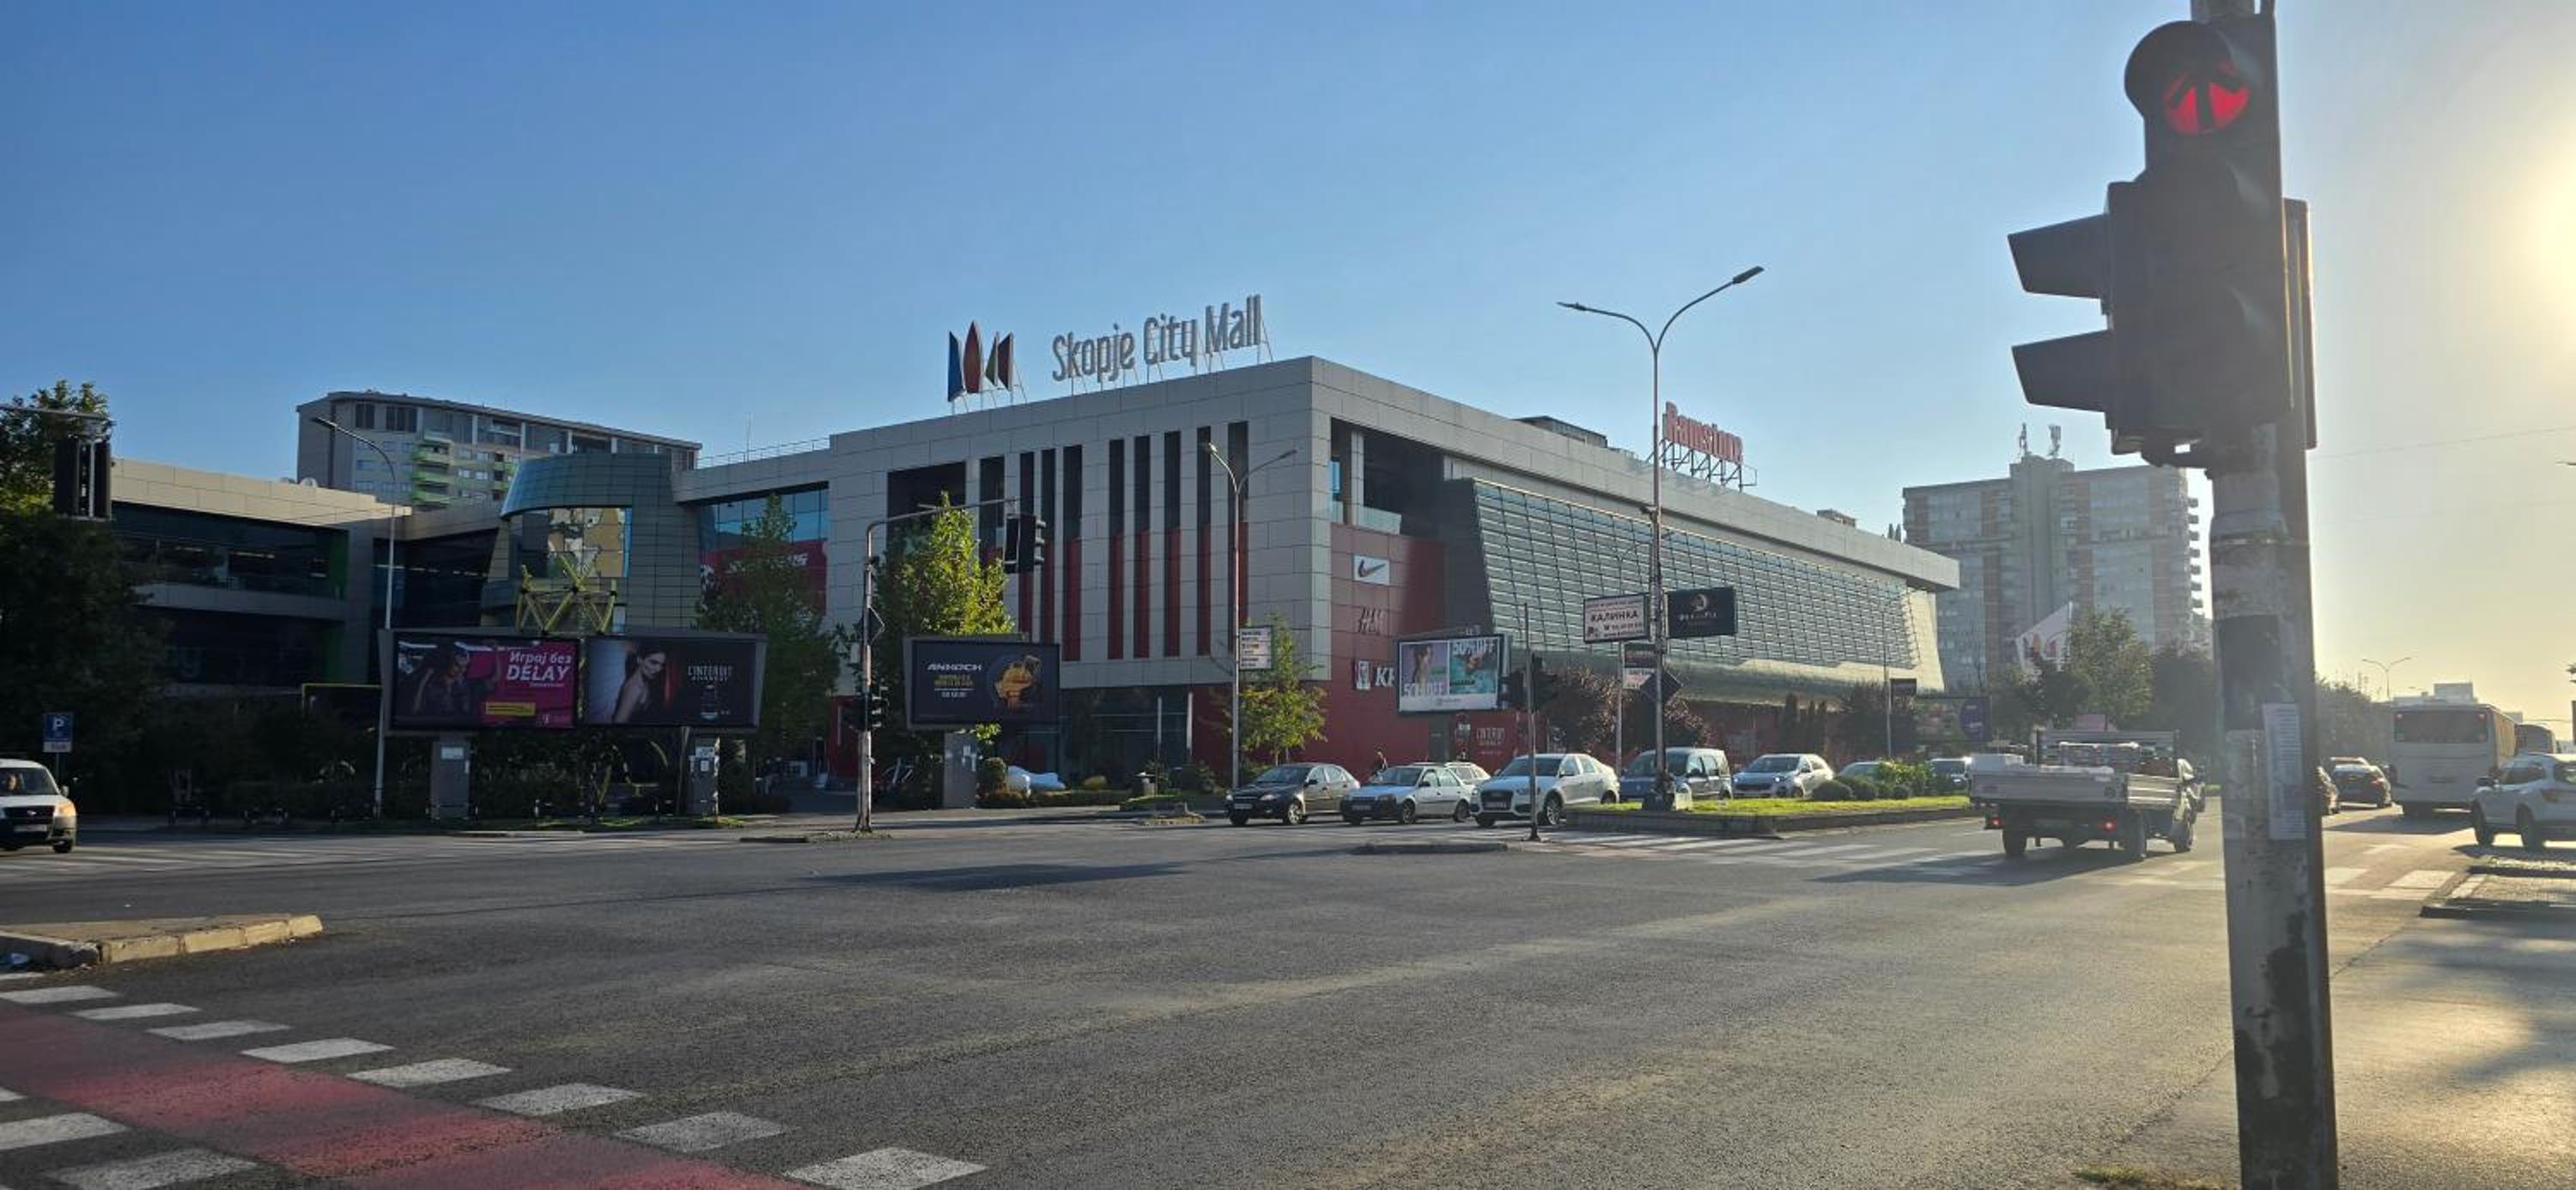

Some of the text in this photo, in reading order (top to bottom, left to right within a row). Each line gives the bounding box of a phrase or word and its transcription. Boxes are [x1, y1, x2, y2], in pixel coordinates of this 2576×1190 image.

[1052, 294, 1261, 383] Skopje City Mall
[1591, 609, 1638, 622] КАЛИНКА
[509, 651, 573, 665] Играј без
[507, 665, 571, 681] DELAY
[52, 717, 65, 731] P
